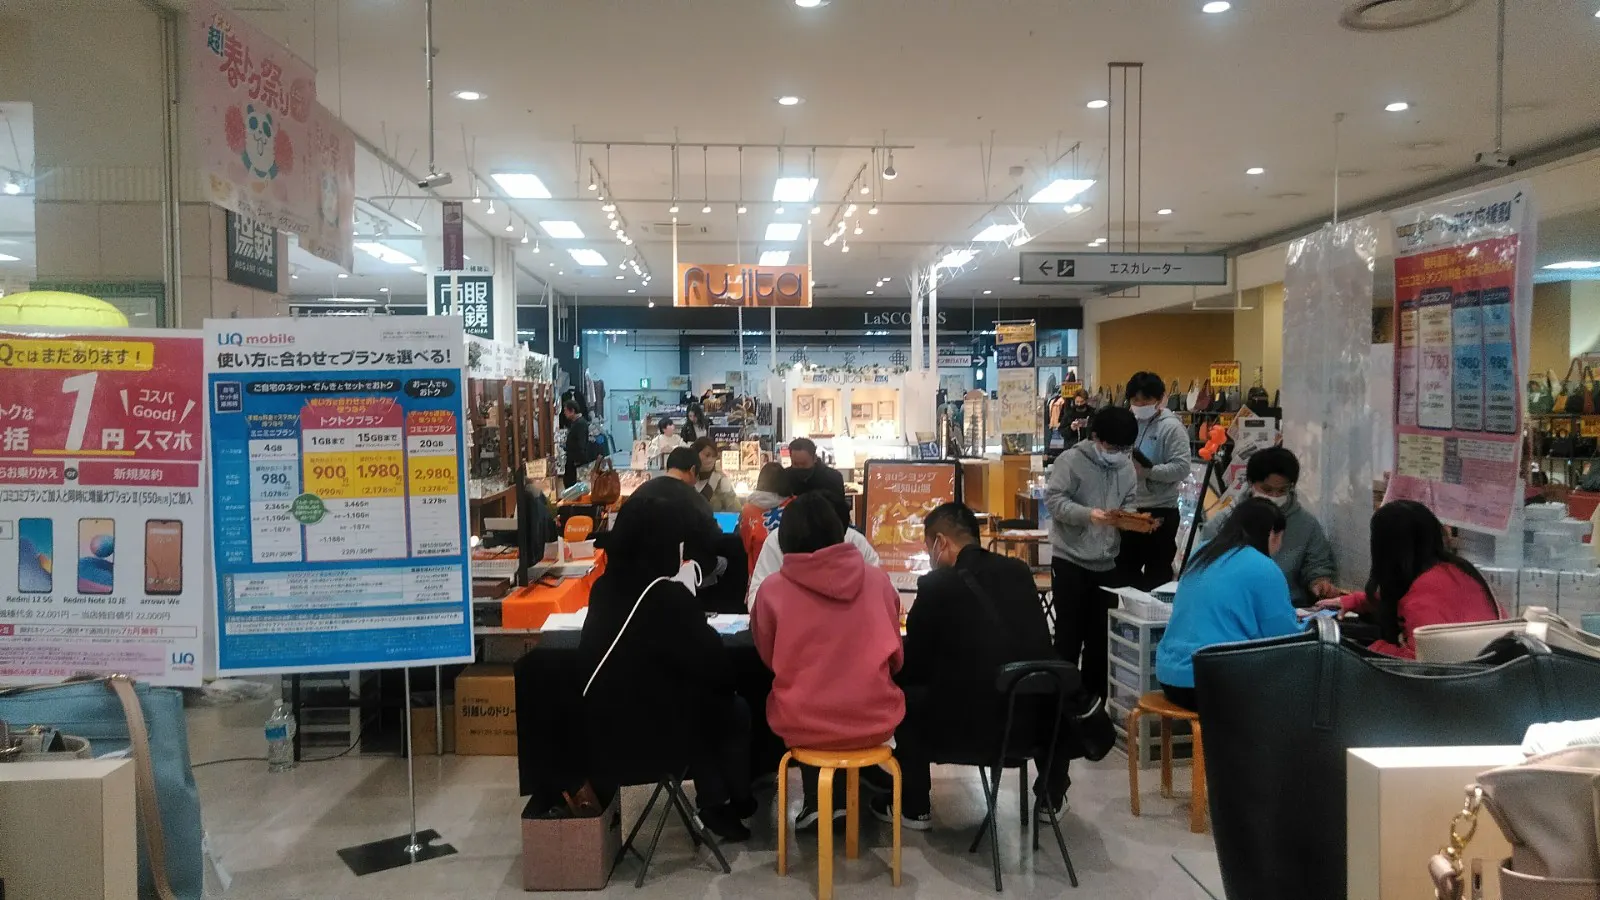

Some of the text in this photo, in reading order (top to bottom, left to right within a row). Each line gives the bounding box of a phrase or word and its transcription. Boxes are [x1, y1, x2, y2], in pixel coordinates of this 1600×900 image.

[1110, 263, 1182, 275] エスカレーター
[218, 333, 295, 346] UQ mobile
[217, 349, 451, 368] 使い方に合わせてプランを選べる!
[412, 380, 448, 388] お一人でも
[419, 388, 441, 396] おトク
[0, 371, 193, 451] 括 1 円 スマホ
[132, 405, 177, 422] Good!
[320, 416, 384, 427] トクトクプラン
[357, 433, 399, 442] 15GBまで
[263, 444, 283, 452] 4GB
[420, 440, 444, 448] 20GB
[113, 468, 163, 481] 新規契約
[313, 465, 347, 479] 900
[261, 473, 288, 484] 980
[172, 652, 195, 665] UQ
